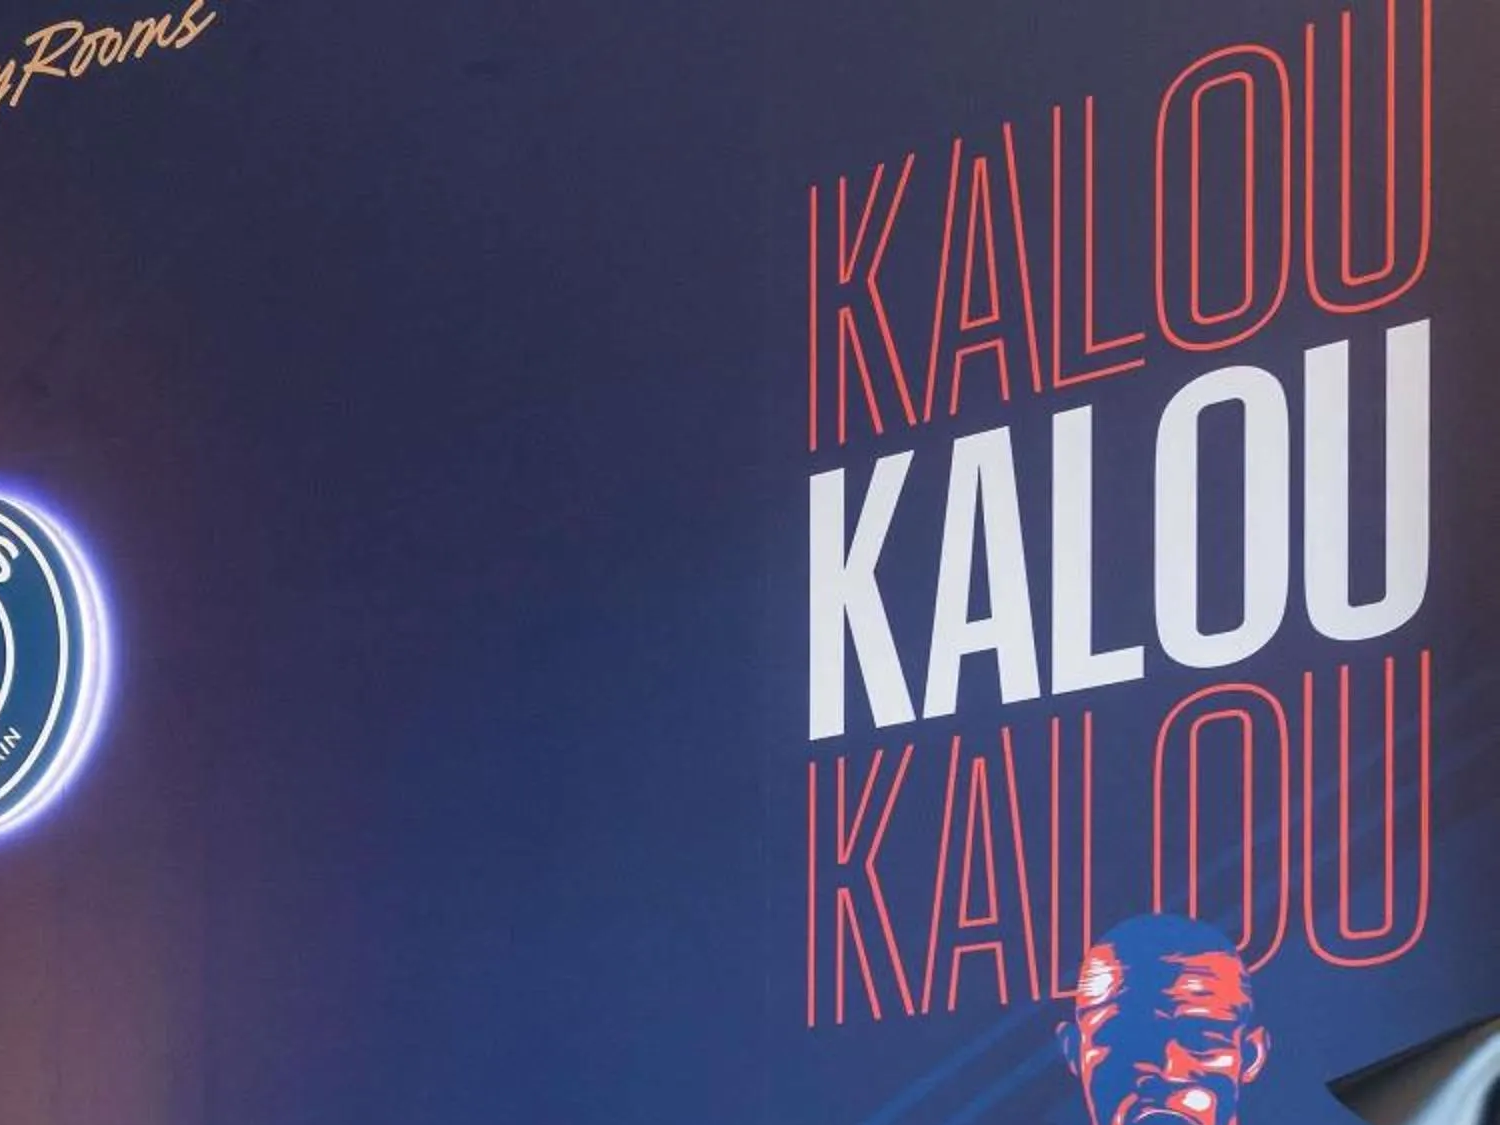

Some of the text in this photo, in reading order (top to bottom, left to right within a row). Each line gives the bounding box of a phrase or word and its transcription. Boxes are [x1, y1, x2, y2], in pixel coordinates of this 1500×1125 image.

[809, 0, 1432, 452] KALOU
[808, 318, 1432, 742] KALOU
[806, 650, 1432, 1028] KALOU
